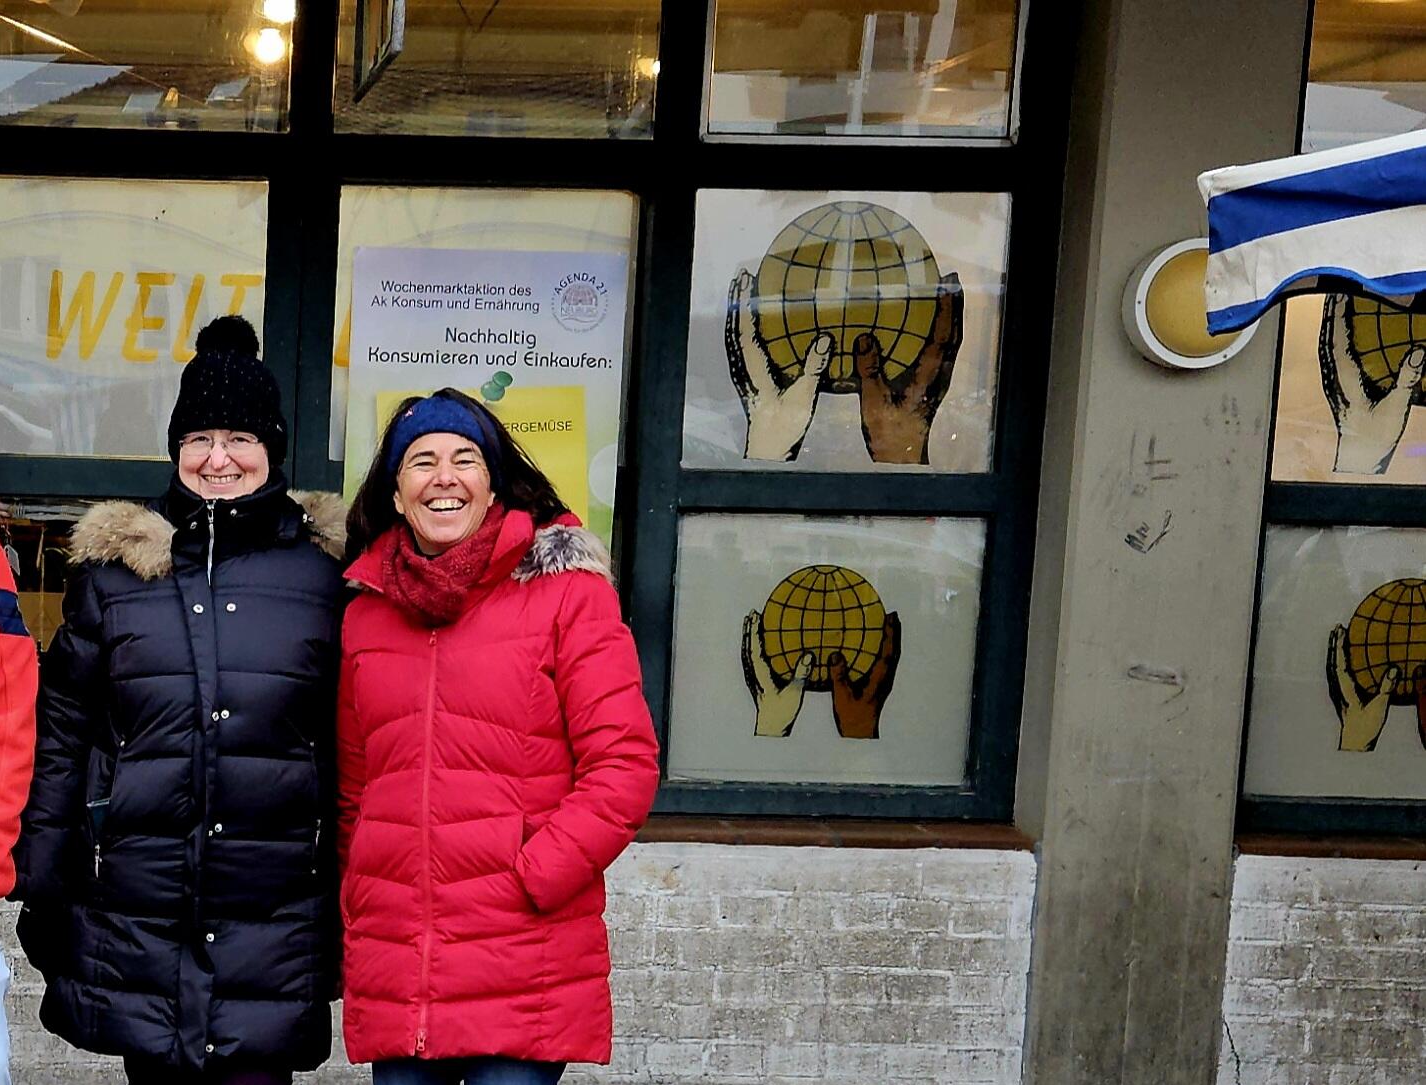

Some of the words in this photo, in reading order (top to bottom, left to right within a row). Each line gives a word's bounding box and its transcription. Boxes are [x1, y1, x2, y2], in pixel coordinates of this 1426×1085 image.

[381, 280, 505, 296] Wochenmarktaktion
[508, 284, 532, 297] des
[554, 272, 596, 295] AGENDA
[596, 282, 608, 296] 21
[45, 268, 263, 363] WELT
[370, 296, 388, 308] Ak
[391, 296, 443, 309] Konsum
[446, 297, 471, 311] und
[474, 298, 540, 314] Ernährung
[445, 327, 537, 349] Nachhaltig
[368, 346, 479, 366] Konsumieren
[485, 350, 517, 367] und
[523, 350, 613, 369] Einkaufen:
